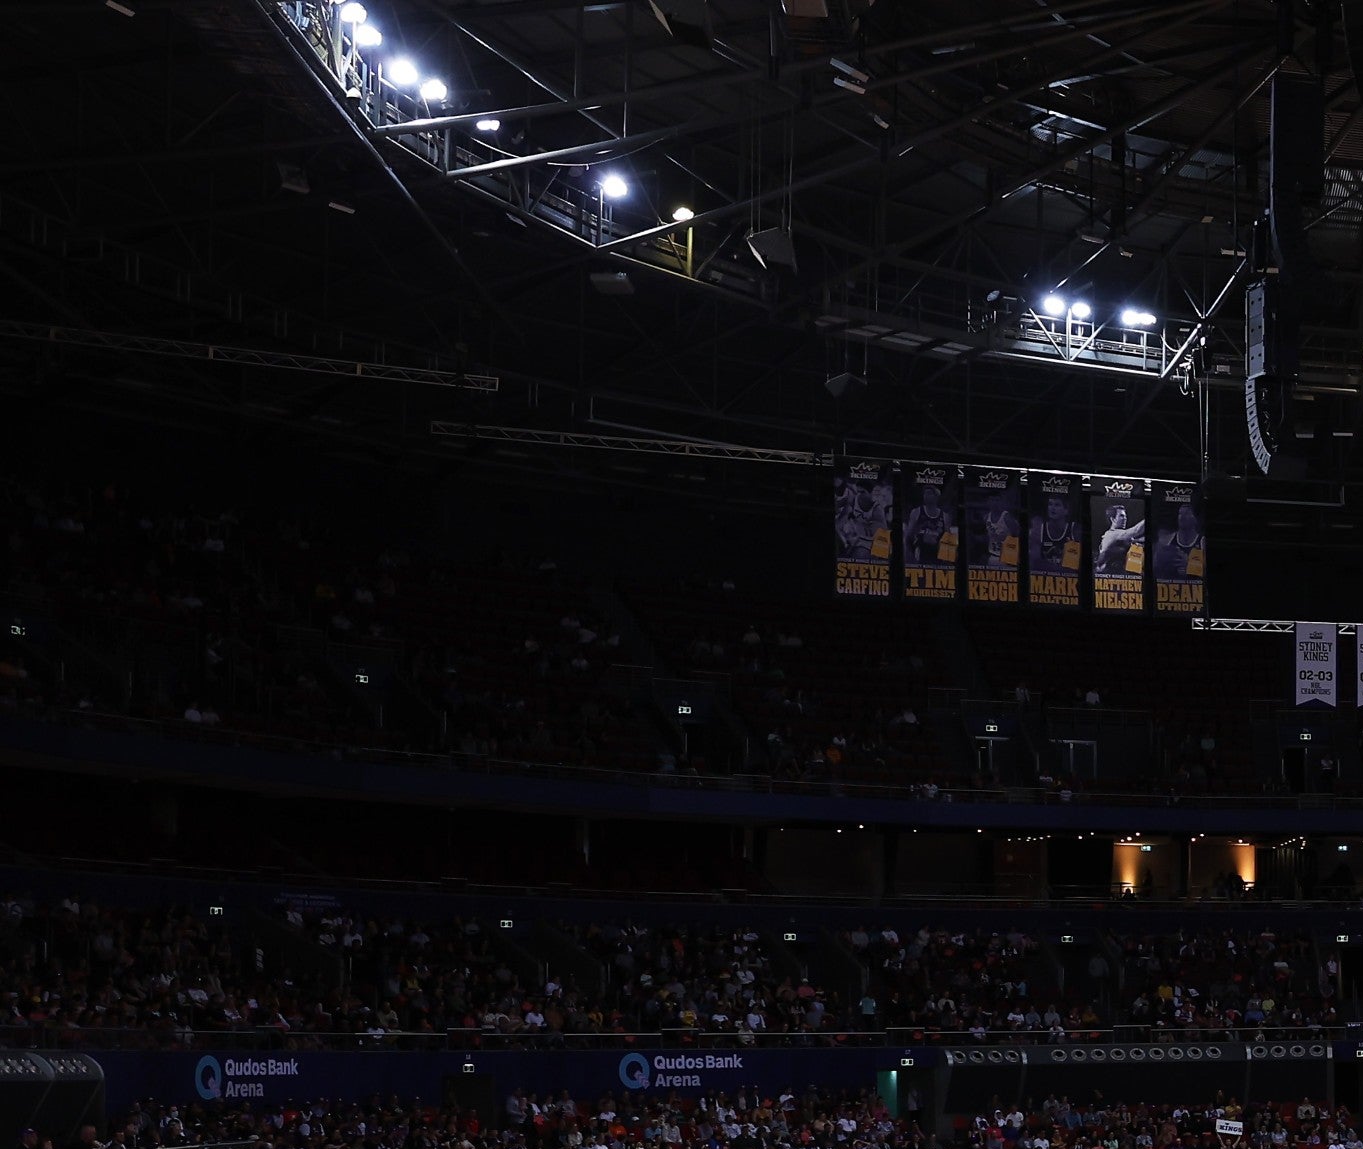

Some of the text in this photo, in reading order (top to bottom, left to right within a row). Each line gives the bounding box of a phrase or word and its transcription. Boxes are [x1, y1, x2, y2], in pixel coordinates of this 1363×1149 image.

[837, 562, 890, 579] STEVE
[905, 568, 956, 590] TIM
[968, 569, 1018, 582] DAMIAN
[836, 578, 890, 597] CARFINO
[968, 580, 1018, 602] KEOGH
[1030, 575, 1079, 595] MARK
[1095, 578, 1143, 592] MATTHEW
[1157, 583, 1203, 603] DEAN
[1095, 591, 1143, 610] NIELSEN
[1299, 642, 1333, 652] SYDNEY
[1303, 652, 1329, 662] KINGS
[1299, 670, 1333, 681] 02-03
[1301, 688, 1331, 696] CHAMPIONS
[225, 1058, 299, 1076] Qudos Bank
[653, 1053, 743, 1070] Qudos Bank
[654, 1073, 701, 1087] Arena
[225, 1081, 264, 1097] Arena
